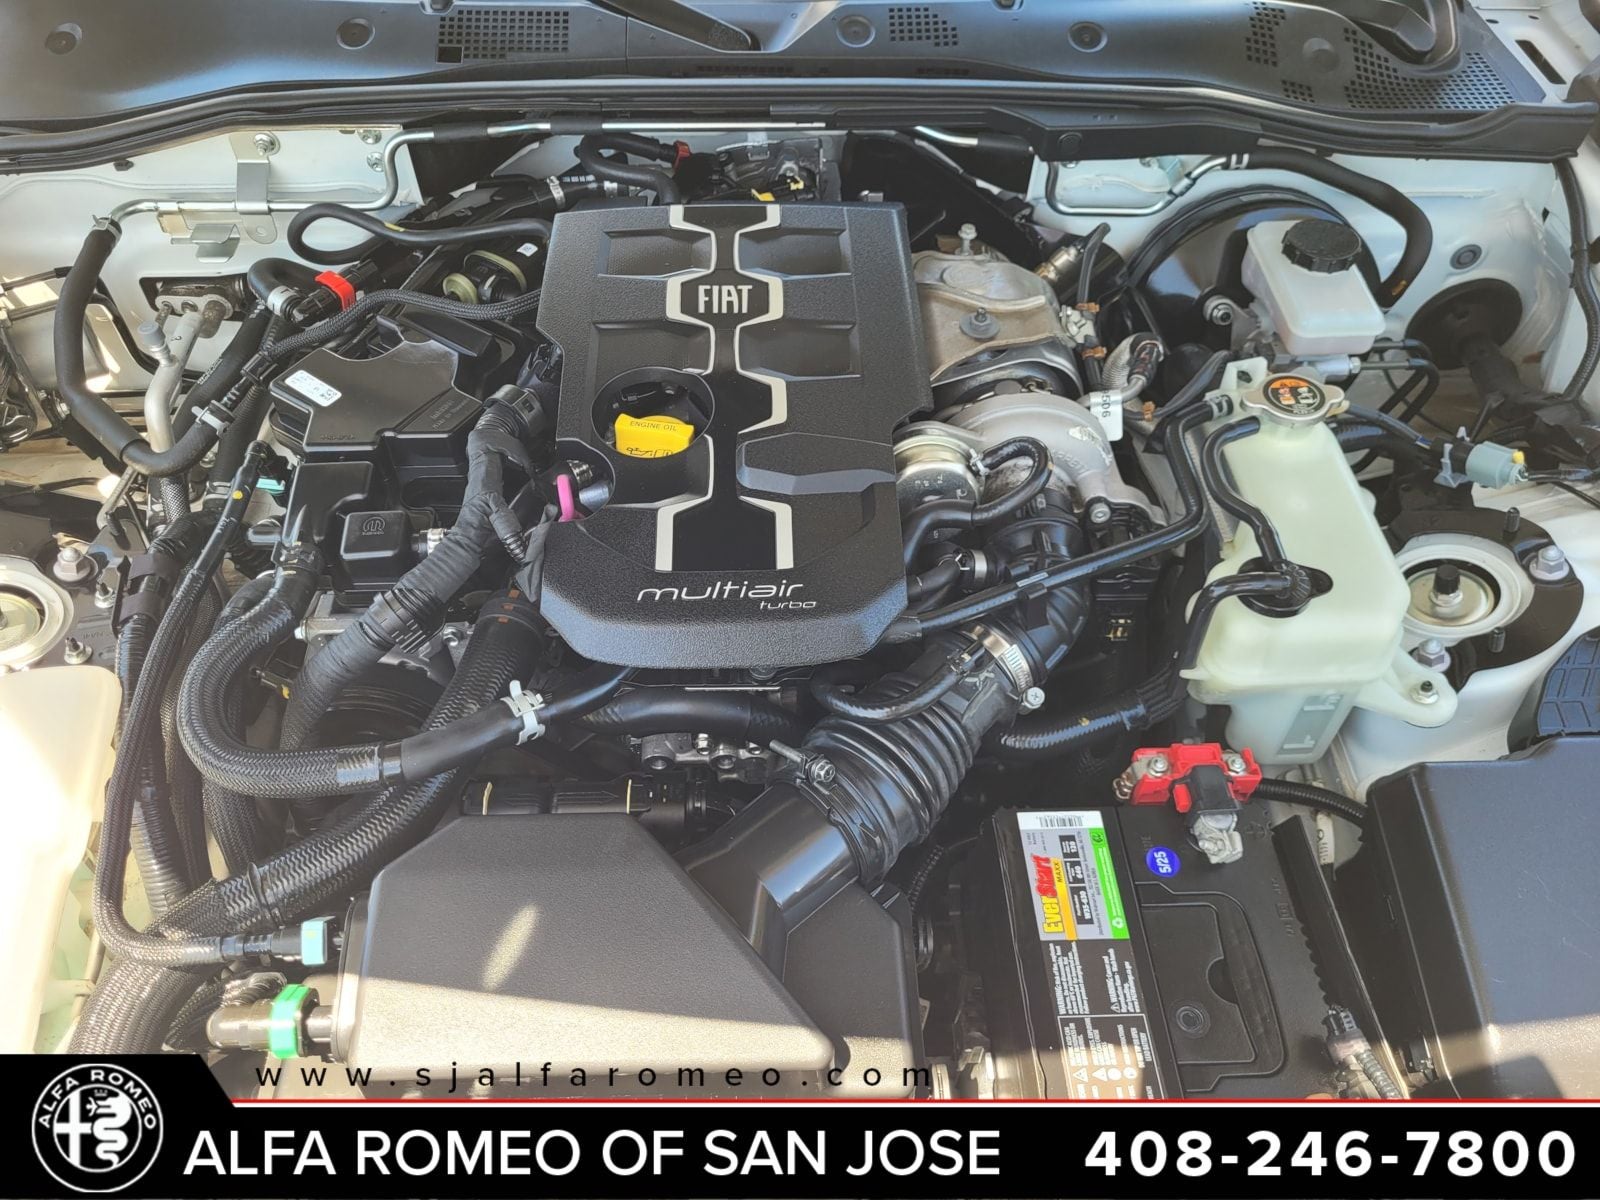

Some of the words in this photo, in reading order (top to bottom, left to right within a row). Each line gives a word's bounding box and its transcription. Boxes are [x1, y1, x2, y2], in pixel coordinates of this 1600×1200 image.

[697, 284, 753, 314] FIAT
[629, 419, 662, 431] ENGINE
[662, 423, 678, 432] OIL
[636, 579, 804, 602] multiair
[759, 600, 817, 610] turbo
[1054, 862, 1063, 883] MAXX
[1075, 866, 1083, 878] 640
[1153, 850, 1172, 875] 5/25
[1031, 854, 1063, 933] EverStart
